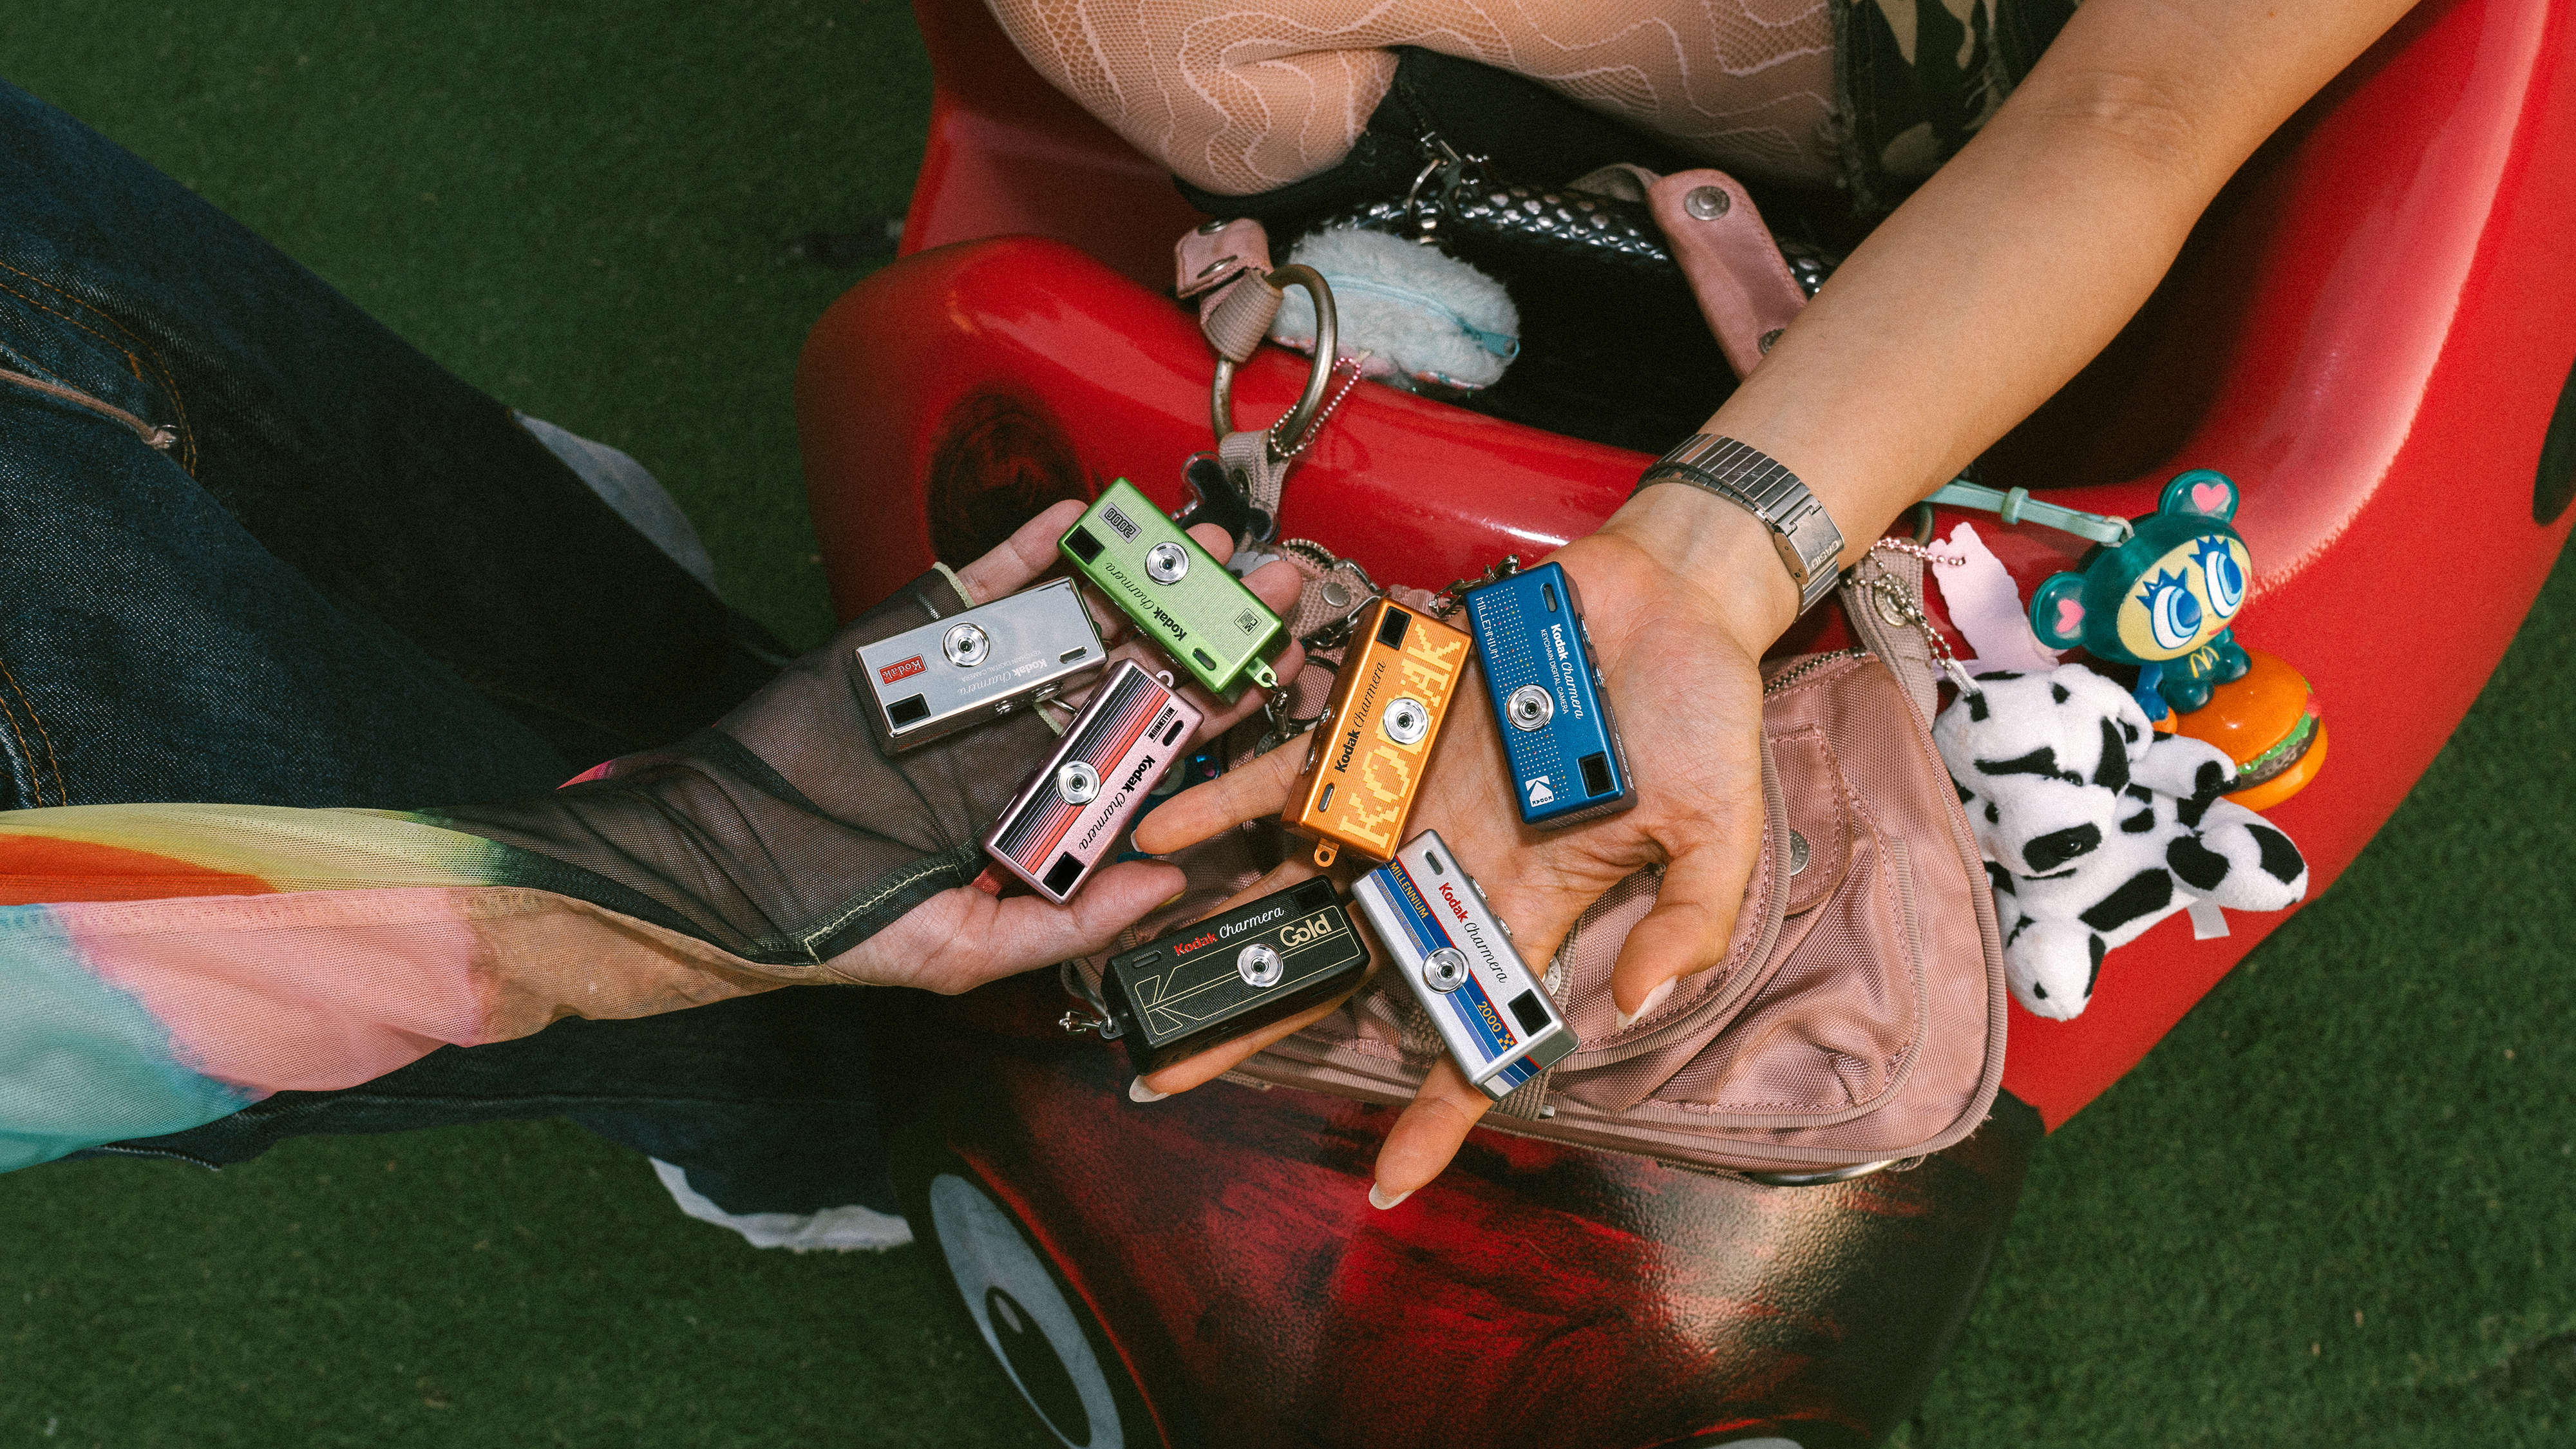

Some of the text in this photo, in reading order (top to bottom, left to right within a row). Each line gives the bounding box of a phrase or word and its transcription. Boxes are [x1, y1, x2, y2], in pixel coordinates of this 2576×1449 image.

[1104, 507, 1136, 538] 2000
[1812, 540, 1839, 569] CASIO
[1105, 563, 1188, 641] Kodak Charmera
[1476, 596, 1499, 659] MILLENNIUM
[882, 659, 922, 680] Kodak
[957, 658, 1048, 696] Kodak Charmera
[961, 650, 1042, 683] KEYCHAIN DIGITAL CAMERA
[1540, 629, 1569, 715] KEYCHAIN DIGITAL CAMERA
[1551, 623, 1584, 719] Kodak Charmera
[1148, 706, 1175, 740] MILLENNIUM
[1334, 729, 1361, 773] Kodak
[1354, 661, 1386, 728] Charmera
[1079, 755, 1155, 850] Kodak Charmera
[1532, 796, 1552, 805] KODAK
[1372, 875, 1421, 948] KEYCHAIN DIGITAL CAMERA
[1389, 862, 1429, 918] MILLENNIUM
[1173, 907, 1285, 956] Kodak Charmera
[1280, 913, 1332, 947] Gold
[1439, 882, 1508, 983] Kodak Charmera
[1477, 1001, 1502, 1032] 2000
